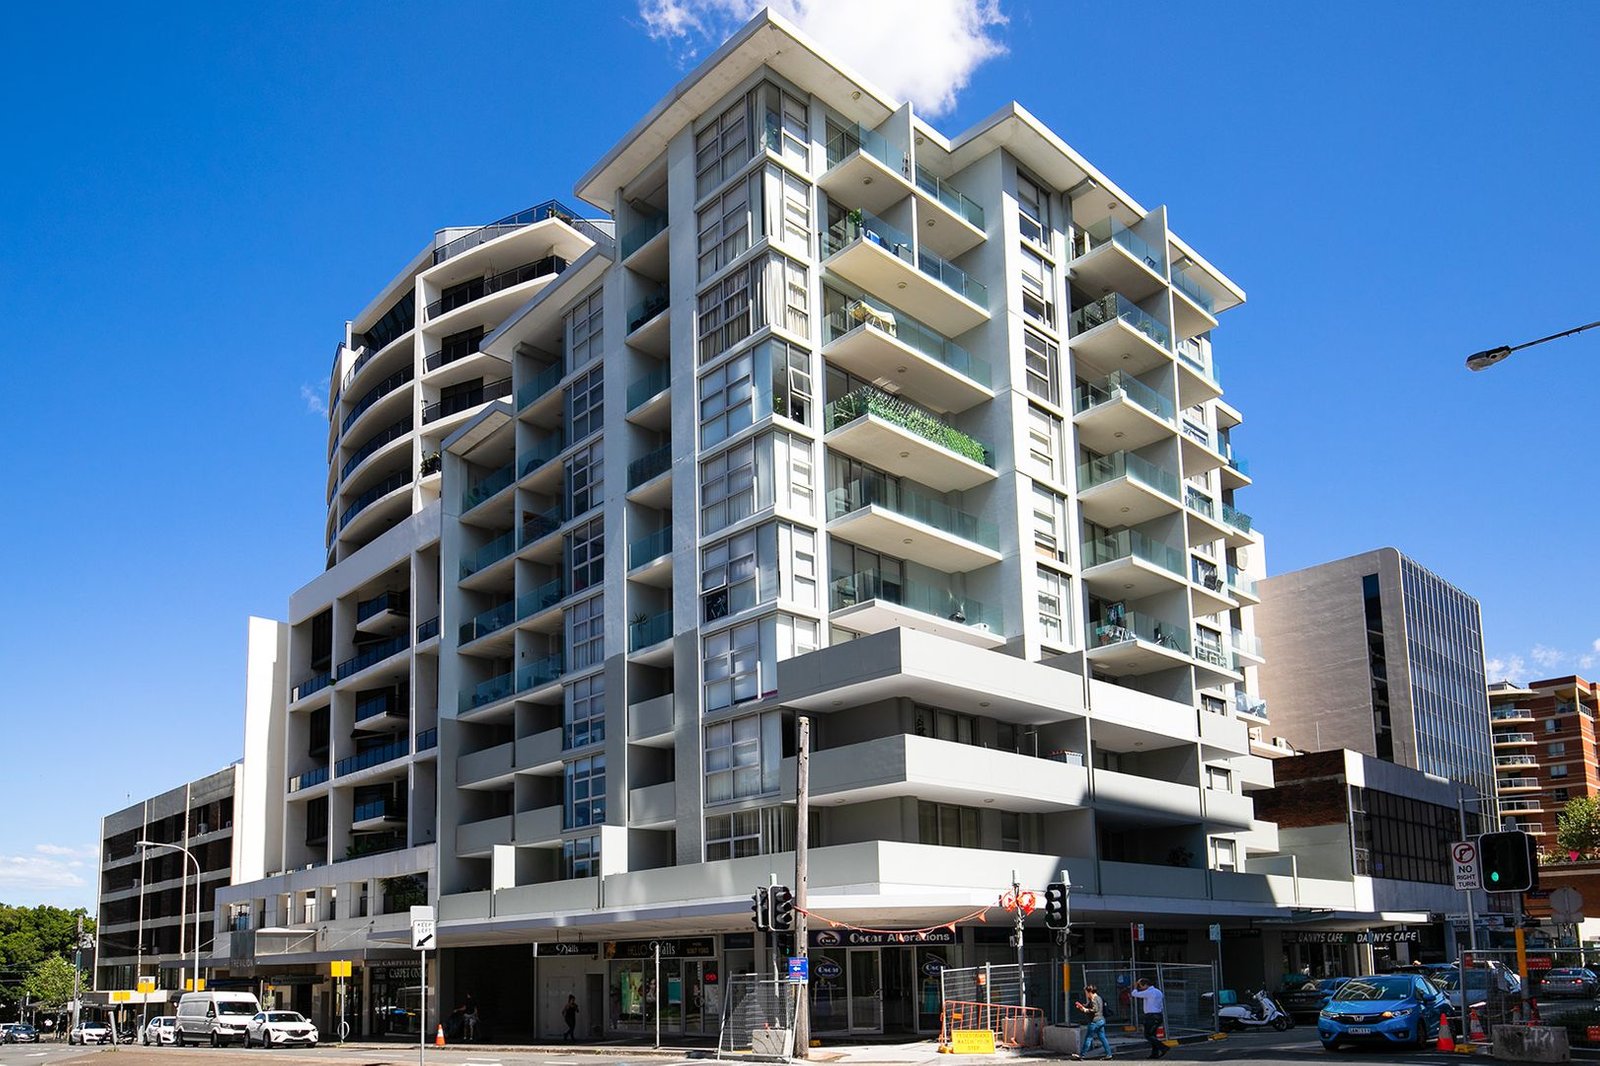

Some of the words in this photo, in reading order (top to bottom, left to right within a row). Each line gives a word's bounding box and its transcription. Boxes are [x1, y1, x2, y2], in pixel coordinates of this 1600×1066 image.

[1459, 865, 1473, 873] NO
[849, 933, 882, 944] Oscar
[1298, 932, 1326, 944] DANNYS
[1327, 931, 1344, 943] CAFE
[1356, 932, 1392, 943] DANYS
[1393, 931, 1417, 941] CAFE
